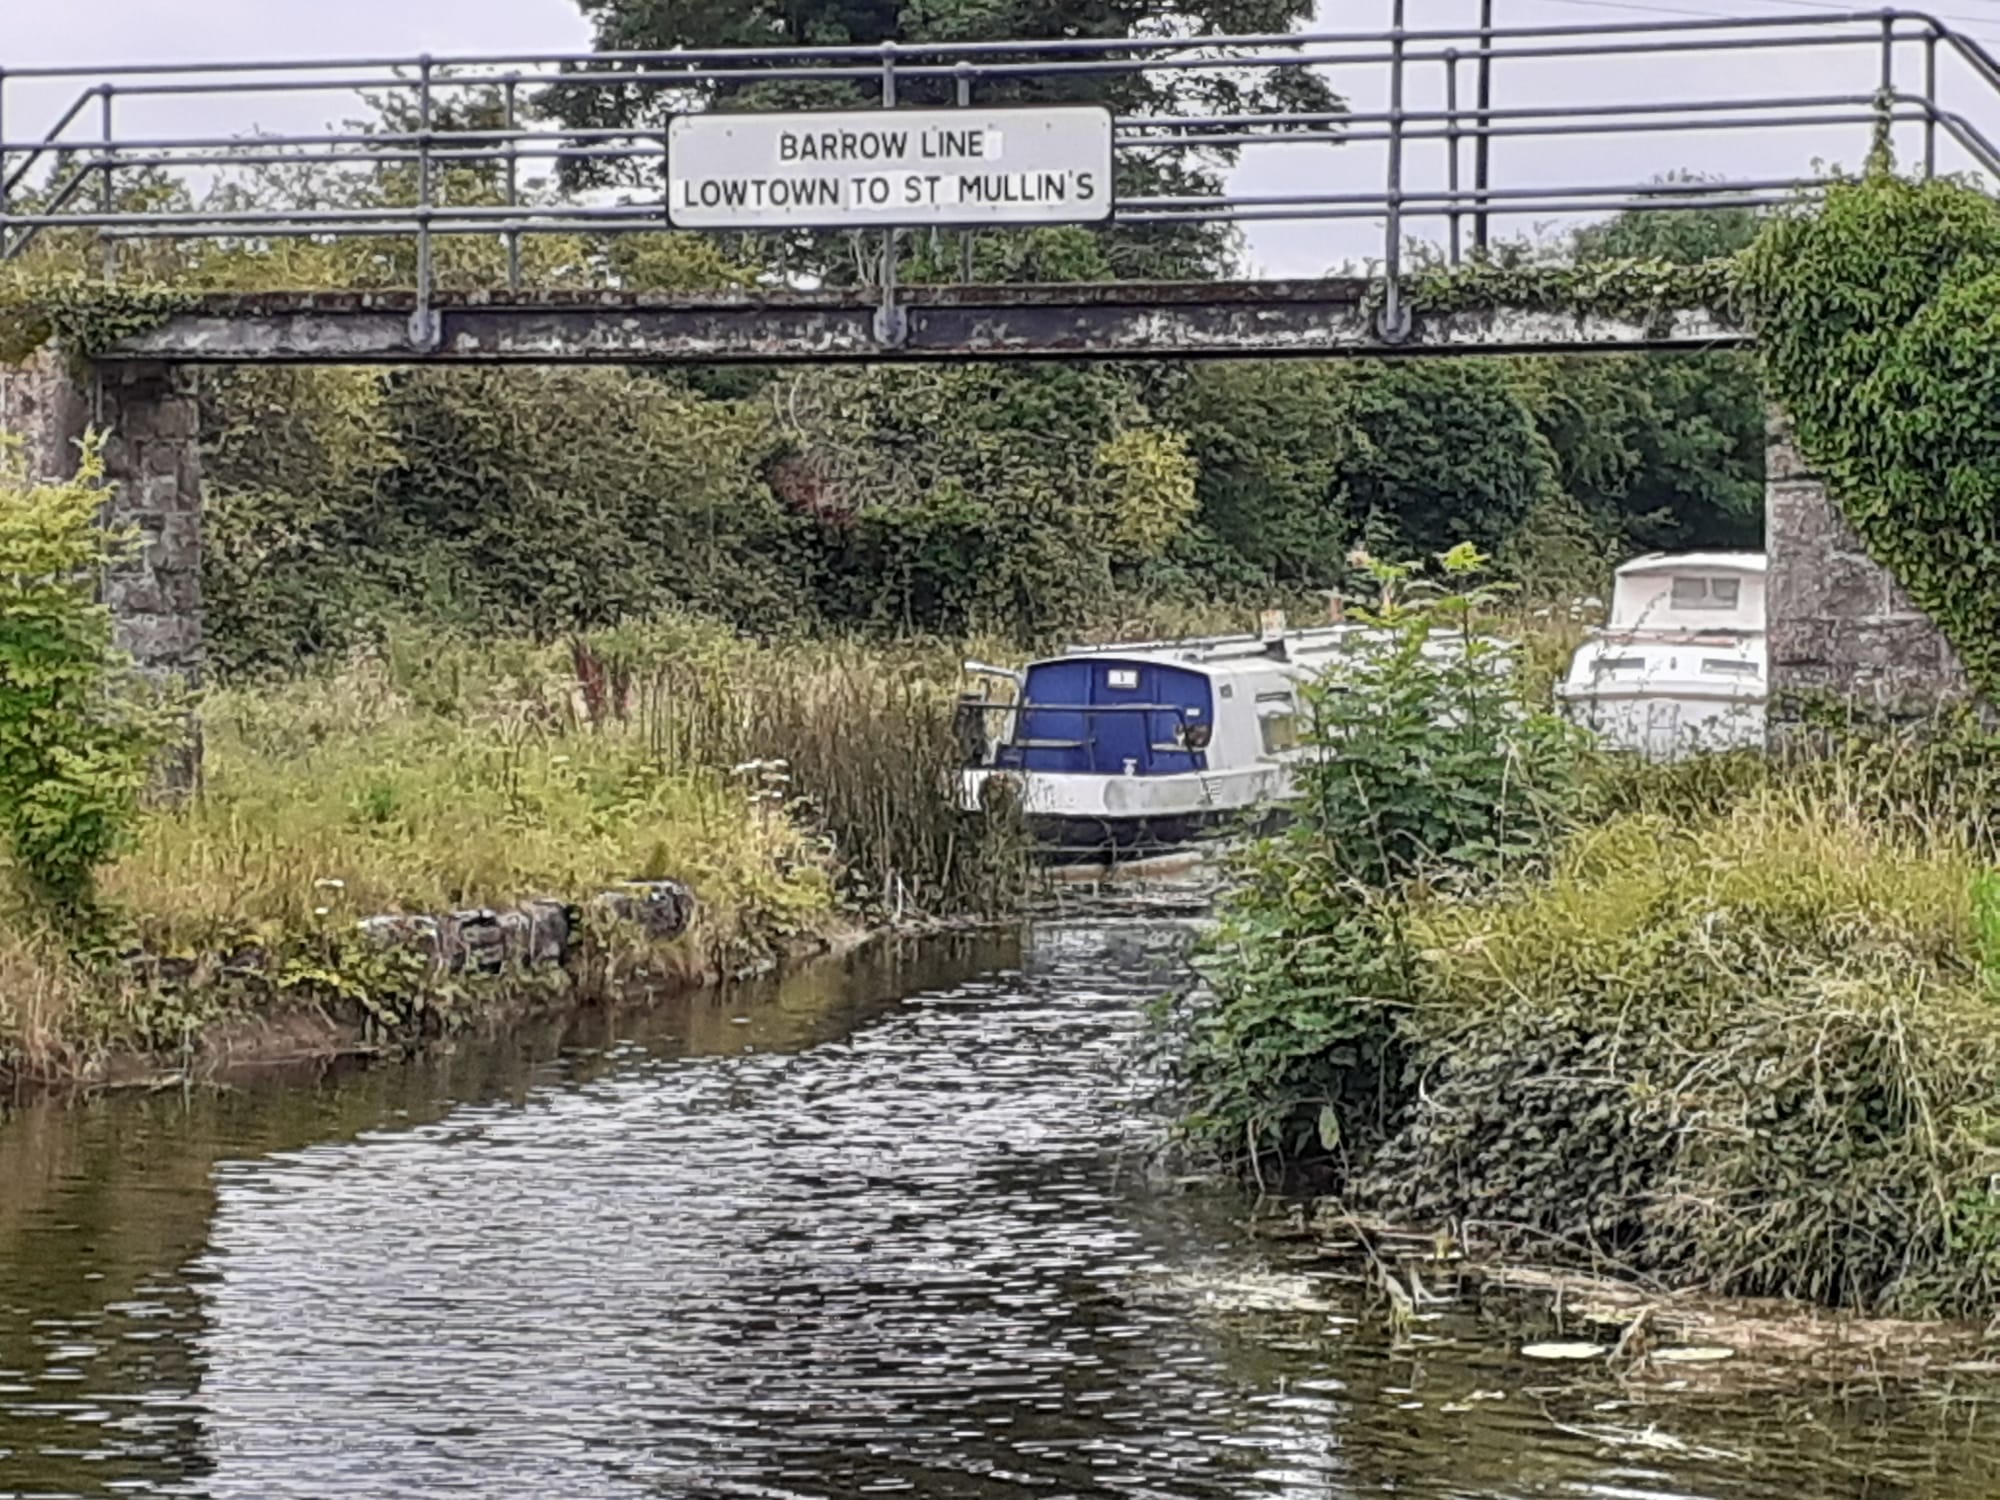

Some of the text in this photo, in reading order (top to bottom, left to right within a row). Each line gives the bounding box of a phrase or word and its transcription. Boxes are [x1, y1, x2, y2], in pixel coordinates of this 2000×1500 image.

[780, 131, 983, 161] BARROW LINE
[684, 170, 1094, 207] LOWTOWN TO ST MULLIN'S
